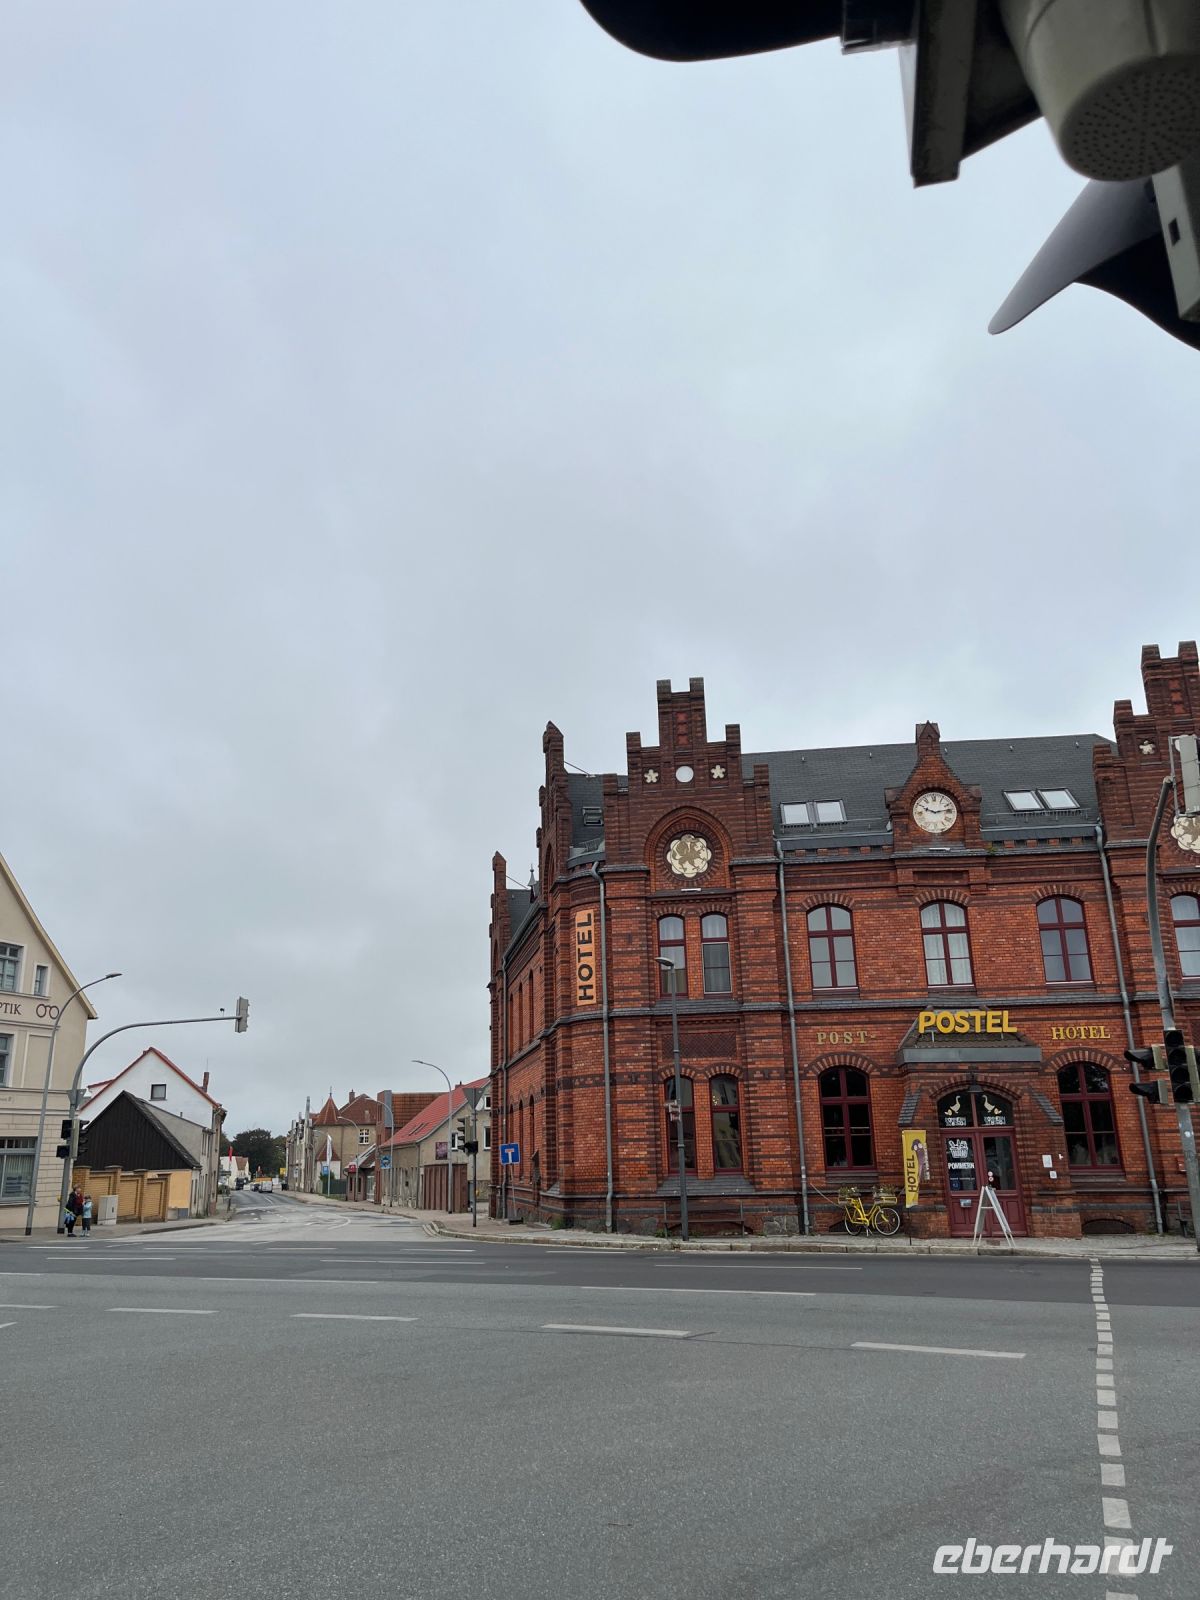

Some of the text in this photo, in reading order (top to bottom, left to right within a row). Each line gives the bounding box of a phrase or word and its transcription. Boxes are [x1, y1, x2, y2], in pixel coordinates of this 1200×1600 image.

[577, 913, 594, 1001] HOTEL
[918, 1010, 1018, 1034] POSTEL
[1051, 1026, 1111, 1040] HOTEL
[906, 1155, 918, 1193] HOTEL
